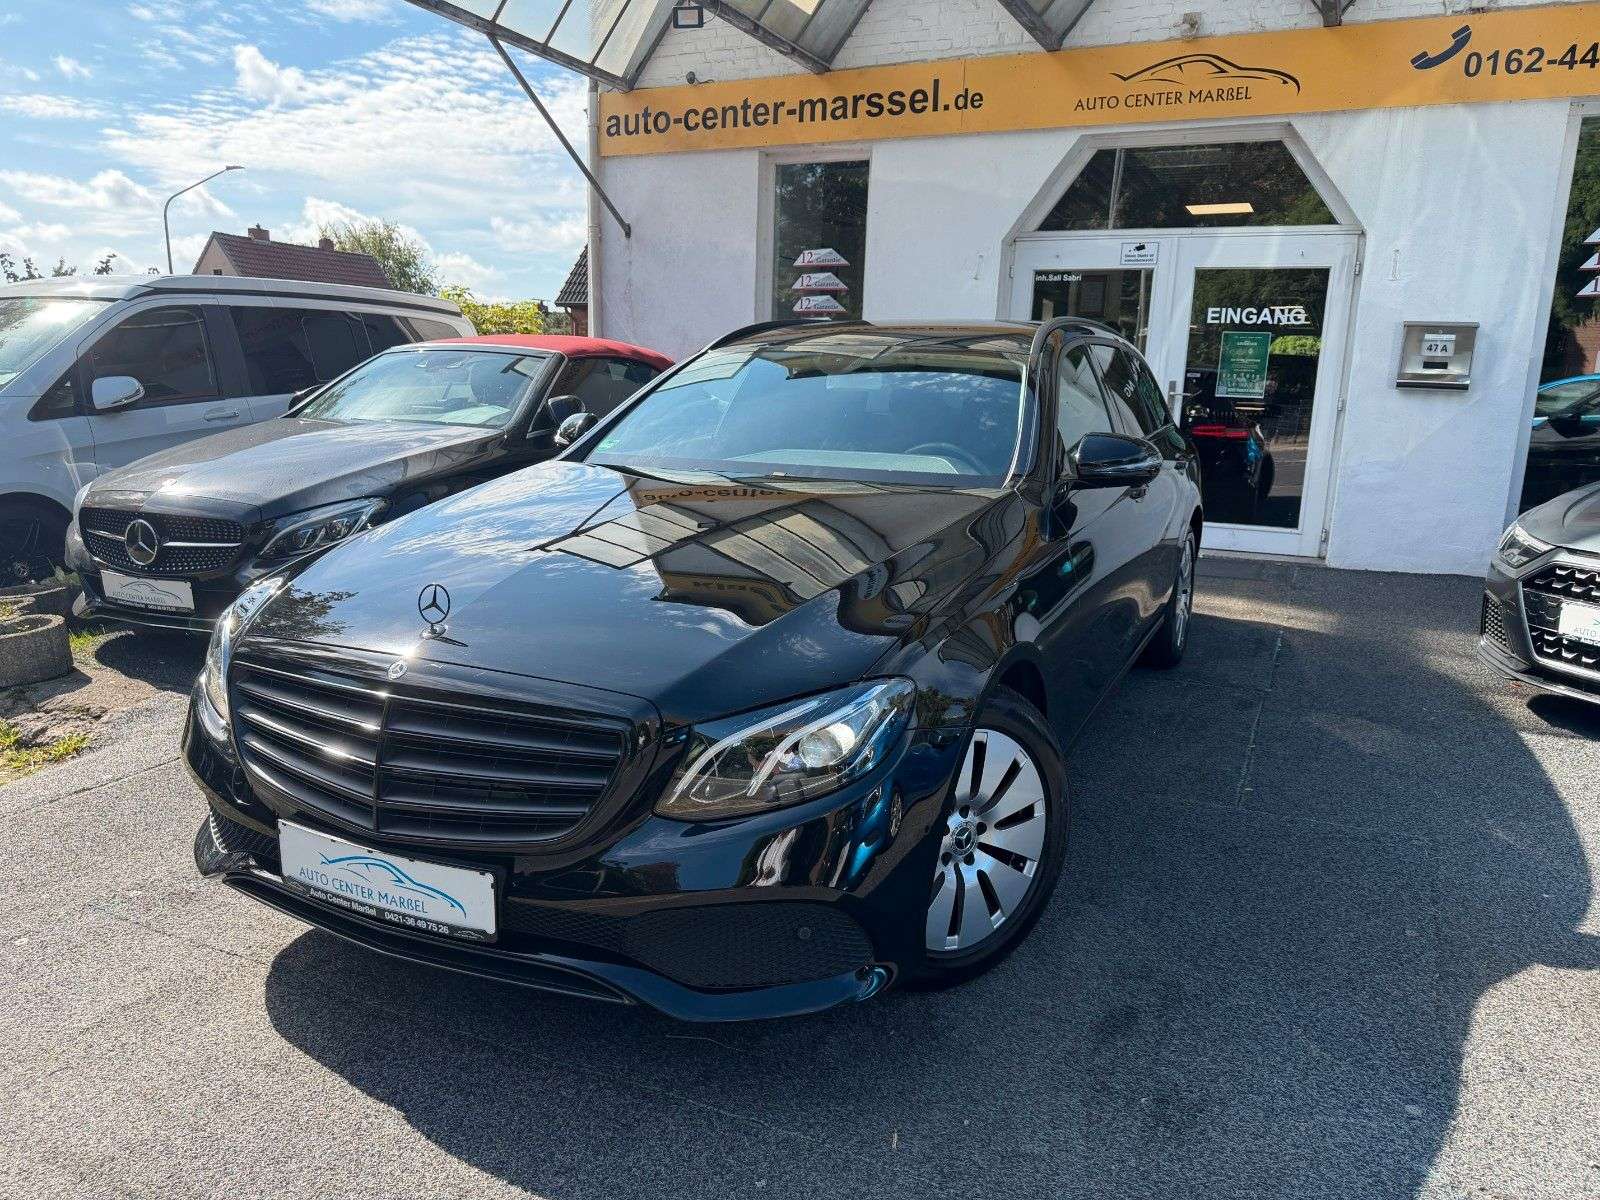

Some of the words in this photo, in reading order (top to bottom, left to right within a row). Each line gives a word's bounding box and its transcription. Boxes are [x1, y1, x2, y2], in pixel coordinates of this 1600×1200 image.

[1463, 41, 1600, 77] 0162-44
[605, 78, 984, 138] auto-center-marssel.de
[1074, 95, 1119, 112] AUTO
[1124, 91, 1183, 108] CENTER
[801, 251, 814, 264] 12
[800, 275, 812, 287] 12
[799, 297, 812, 310] 12
[1206, 306, 1307, 325] EINGANG
[1426, 343, 1439, 352] 47
[1440, 344, 1448, 353] A
[299, 866, 329, 885] AUTO
[331, 877, 374, 901] CENTER
[310, 887, 326, 900] Auto
[327, 893, 351, 908] Center
[416, 920, 427, 929] 49
[427, 921, 438, 932] 75
[438, 924, 449, 934] 26
